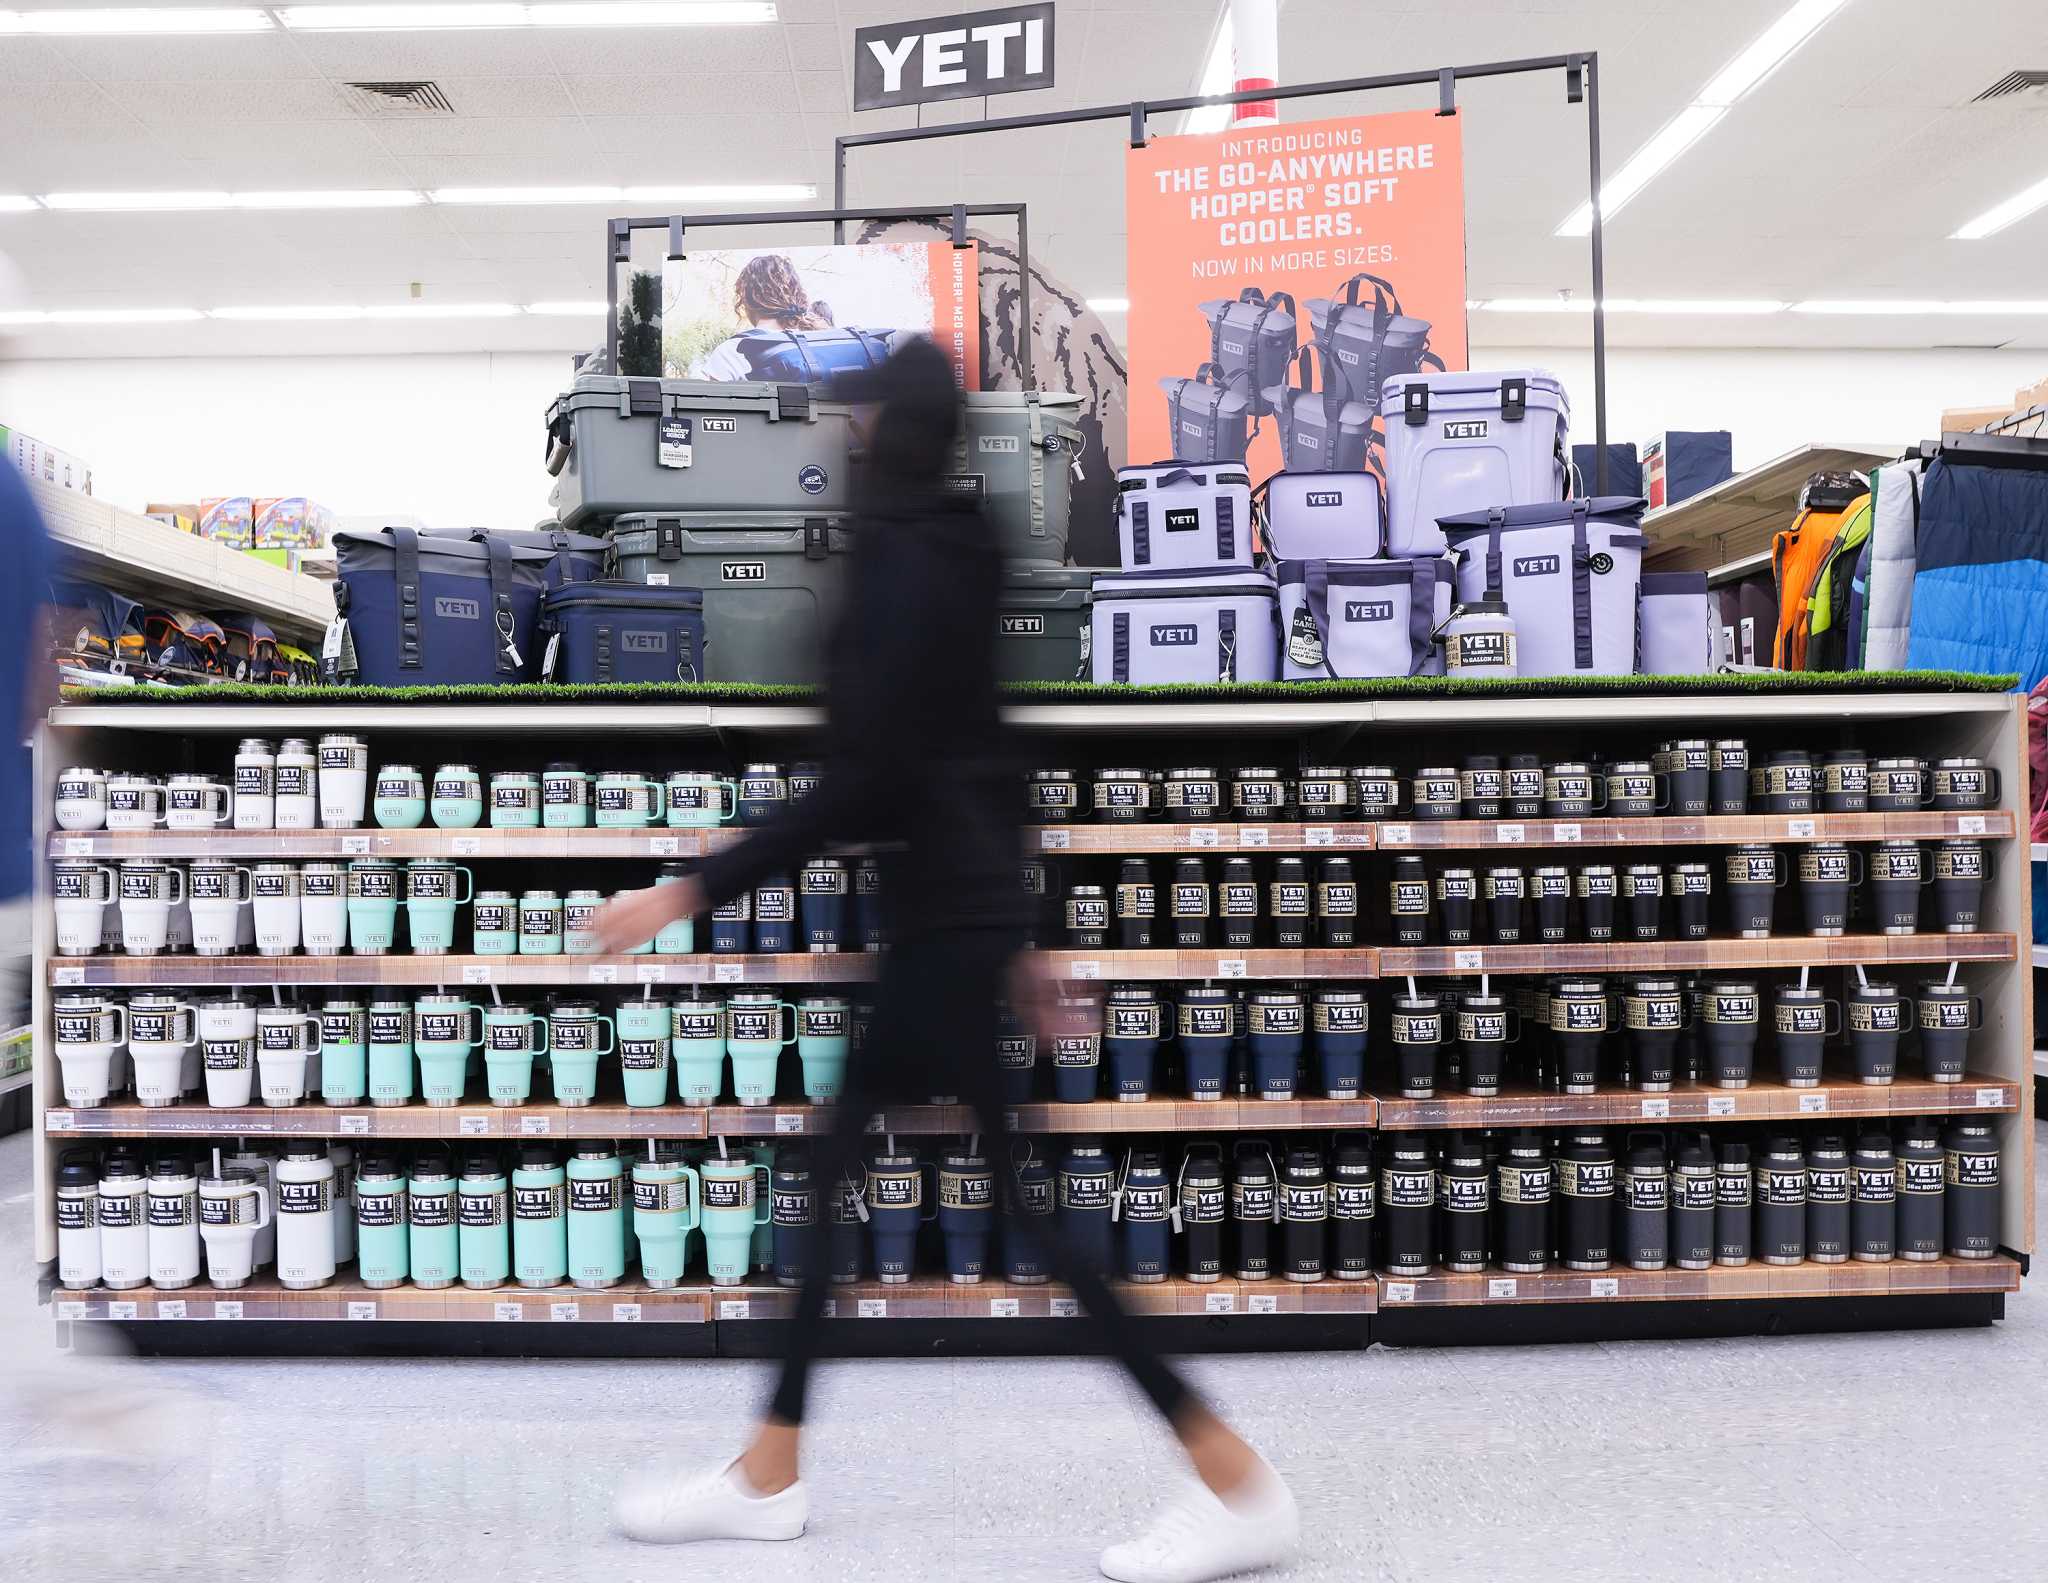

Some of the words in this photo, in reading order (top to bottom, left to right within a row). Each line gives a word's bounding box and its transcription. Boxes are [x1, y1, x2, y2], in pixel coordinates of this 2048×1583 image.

[866, 19, 1043, 92] YETI
[1222, 129, 1362, 158] INTRODUCING
[1155, 167, 1209, 193] THE
[1219, 144, 1434, 189] GO-ANYWHERE
[1324, 177, 1399, 207] SOFT
[1220, 212, 1362, 246] COOLERS.
[1192, 258, 1237, 279] NOW
[1245, 256, 1263, 273] IN
[1271, 250, 1327, 272] MORE
[1334, 245, 1398, 266] SIZES.
[953, 306, 964, 328] M20
[953, 331, 964, 359] SOFT
[1224, 343, 1242, 354] YETI
[1339, 352, 1358, 364] YETI
[704, 420, 734, 431] YETI
[1183, 423, 1200, 435] YETI
[1445, 423, 1485, 437] YETI
[982, 439, 1015, 450] YETI
[1299, 435, 1317, 448] YETI
[1309, 494, 1340, 504] YETI
[1170, 515, 1195, 525] YETI
[1517, 559, 1555, 572] YETI
[725, 563, 763, 579] YETI
[440, 601, 475, 615] YETI
[1349, 605, 1389, 618] YETI
[1004, 617, 1041, 631] YETI
[1154, 628, 1192, 641] YETI
[625, 635, 663, 649] YETI
[1463, 636, 1500, 648] YETI
[322, 748, 347, 758] YETI
[238, 767, 260, 776] YETI
[279, 767, 301, 776] YETI
[1512, 772, 1539, 782] YETI
[1892, 774, 1917, 783] YETI
[1952, 773, 1978, 782] YETI
[545, 780, 570, 790] YETI
[1185, 784, 1211, 793] YETI
[1304, 784, 1328, 793] YETI
[1361, 783, 1386, 793] YETI
[1429, 782, 1453, 792] YETI
[1561, 781, 1585, 789] YETI
[1627, 779, 1649, 788] YETI
[499, 790, 523, 798] YETI
[674, 788, 699, 797] YETI
[1041, 786, 1066, 795] YETI
[1110, 786, 1135, 794] YETI
[1244, 784, 1270, 794] YETI
[112, 791, 136, 800] YETI
[600, 790, 624, 799] YETI
[1819, 857, 1845, 867] YETI
[1890, 856, 1917, 866] YETI
[1952, 854, 1979, 864] YETI
[1749, 860, 1773, 869] YETI
[124, 876, 150, 886] YETI
[194, 876, 219, 886] YETI
[257, 878, 281, 886] YETI
[306, 877, 333, 886] YETI
[363, 874, 391, 884] YETI
[415, 874, 443, 884] YETI
[809, 874, 835, 882] YETI
[1543, 879, 1564, 887] YETI
[1635, 878, 1657, 886] YETI
[1178, 888, 1201, 896] YETI
[1229, 888, 1252, 896] YETI
[1282, 888, 1304, 896] YETI
[1399, 886, 1422, 895] YETI
[476, 907, 501, 916] YETI
[1077, 904, 1103, 912] YETI
[524, 911, 551, 920] YETI
[1720, 998, 1751, 1009] YETI
[1194, 1010, 1224, 1020] YETI
[1267, 1009, 1299, 1020] YETI
[1331, 1008, 1362, 1019] YETI
[1571, 1005, 1600, 1015] YETI
[1795, 1010, 1821, 1020] YETI
[1873, 1007, 1898, 1018] YETI
[1941, 1006, 1967, 1016] YETI
[372, 1016, 400, 1026] YETI
[682, 1016, 715, 1026] YETI
[736, 1015, 767, 1026] YETI
[1119, 1011, 1148, 1021] YETI
[60, 1018, 88, 1029] YETI
[133, 1018, 160, 1028] YETI
[424, 1016, 453, 1027] YETI
[1409, 1020, 1436, 1030] YETI
[1475, 1017, 1502, 1027] YETI
[264, 1027, 292, 1037] YETI
[494, 1028, 521, 1037] YETI
[557, 1027, 584, 1037] YETI
[205, 1043, 238, 1054] YETI
[623, 1042, 654, 1053] YETI
[1058, 1039, 1090, 1050] YETI
[1963, 1156, 1997, 1168] YETI
[1581, 1166, 1612, 1178] YETI
[1907, 1164, 1940, 1176] YETI
[1393, 1176, 1428, 1188] YETI
[1521, 1173, 1550, 1184] YETI
[1717, 1178, 1746, 1189] YETI
[1772, 1175, 1804, 1187] YETI
[1810, 1173, 1845, 1185] YETI
[572, 1182, 608, 1194] YETI
[708, 1182, 736, 1193] YETI
[880, 1180, 909, 1190] YETI
[1071, 1178, 1106, 1190] YETI
[1452, 1182, 1485, 1194] YETI
[1635, 1181, 1664, 1192] YETI
[1688, 1180, 1714, 1192] YETI
[281, 1185, 317, 1197] YETI
[1245, 1190, 1271, 1201] YETI
[1338, 1188, 1371, 1200] YETI
[517, 1191, 549, 1202] YETI
[1128, 1191, 1162, 1203] YETI
[1200, 1193, 1224, 1203] YETI
[202, 1200, 227, 1210] YETI
[413, 1198, 447, 1209] YETI
